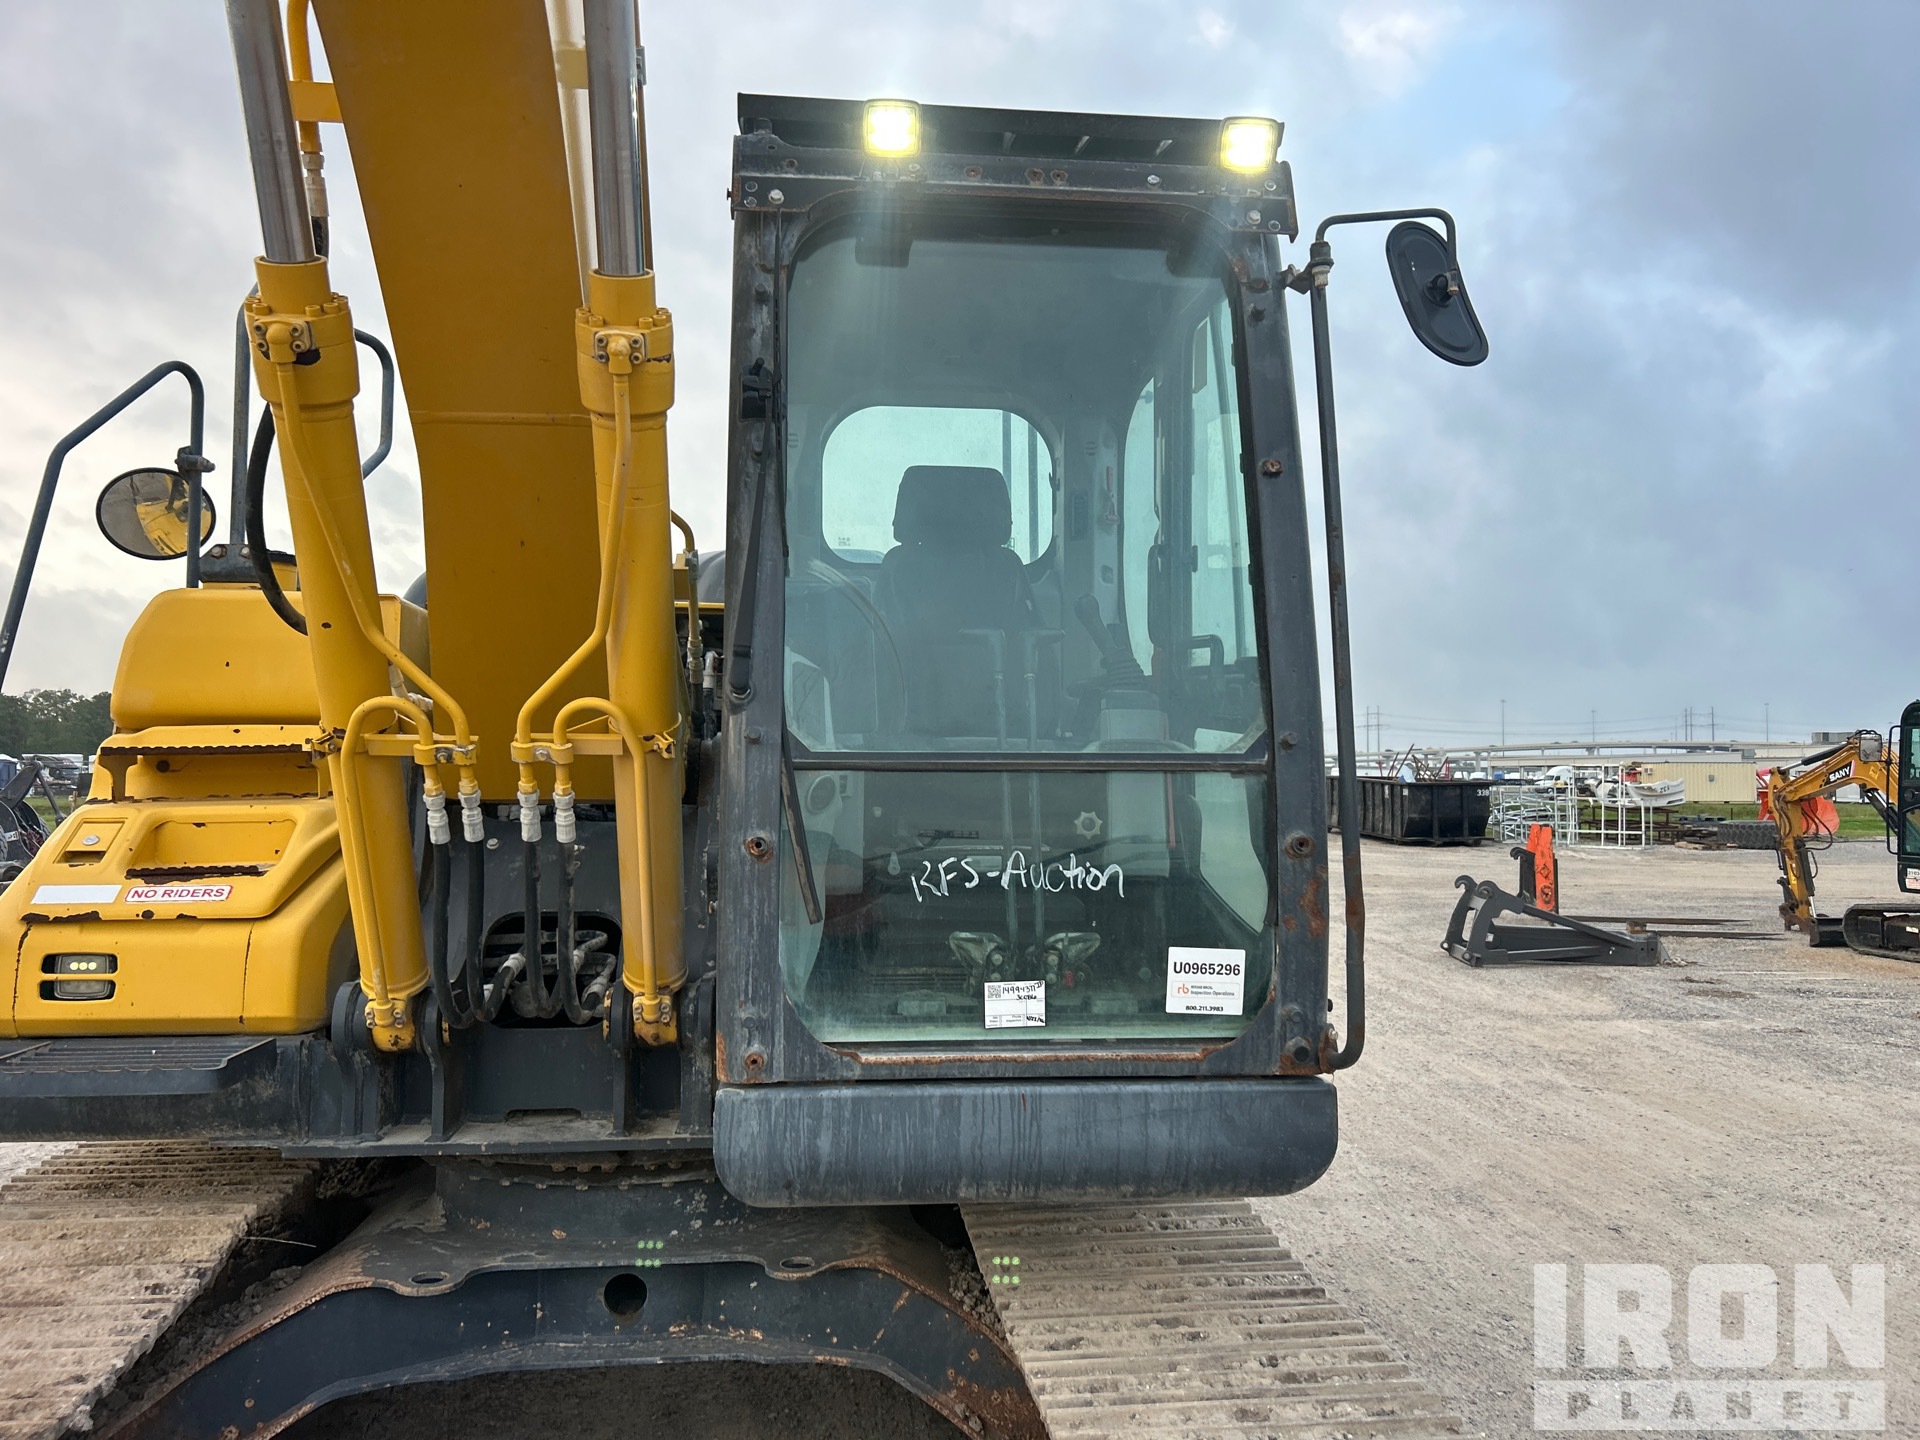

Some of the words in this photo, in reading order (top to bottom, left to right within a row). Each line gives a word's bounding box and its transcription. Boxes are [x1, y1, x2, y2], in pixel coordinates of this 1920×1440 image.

[1829, 766, 1850, 782] SANY
[131, 888, 158, 899] NO
[161, 887, 225, 899] RIDERS
[1173, 961, 1241, 976] U0965296
